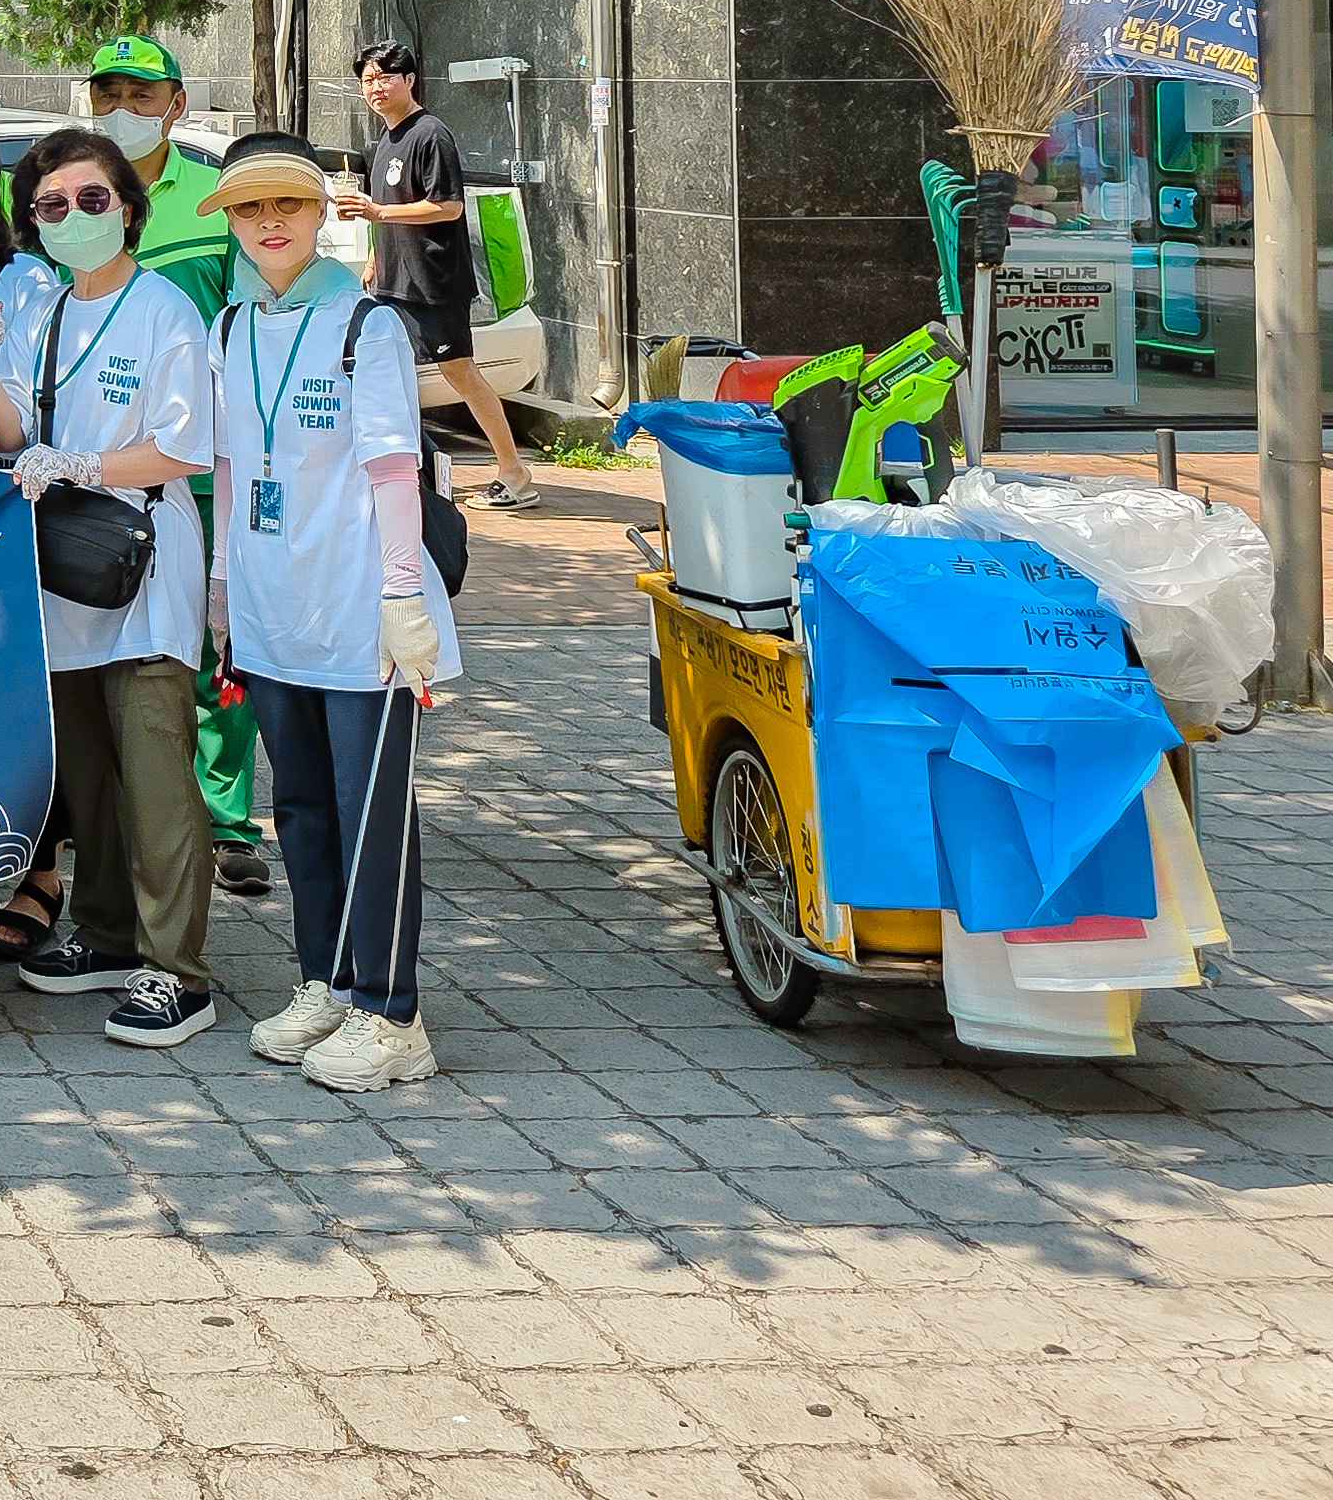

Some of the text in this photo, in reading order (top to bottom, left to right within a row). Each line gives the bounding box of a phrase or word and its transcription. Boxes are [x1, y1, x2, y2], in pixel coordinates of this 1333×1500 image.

[1033, 266, 1098, 280] YOUR
[995, 295, 1100, 308] UPHORIA
[108, 355, 138, 372] VISIT
[302, 378, 337, 394] VISIT
[292, 395, 342, 412] SUWON
[298, 413, 336, 431] YEAR
[1021, 605, 1106, 618] SUWON CITY
[1023, 619, 1109, 651] 수원시
